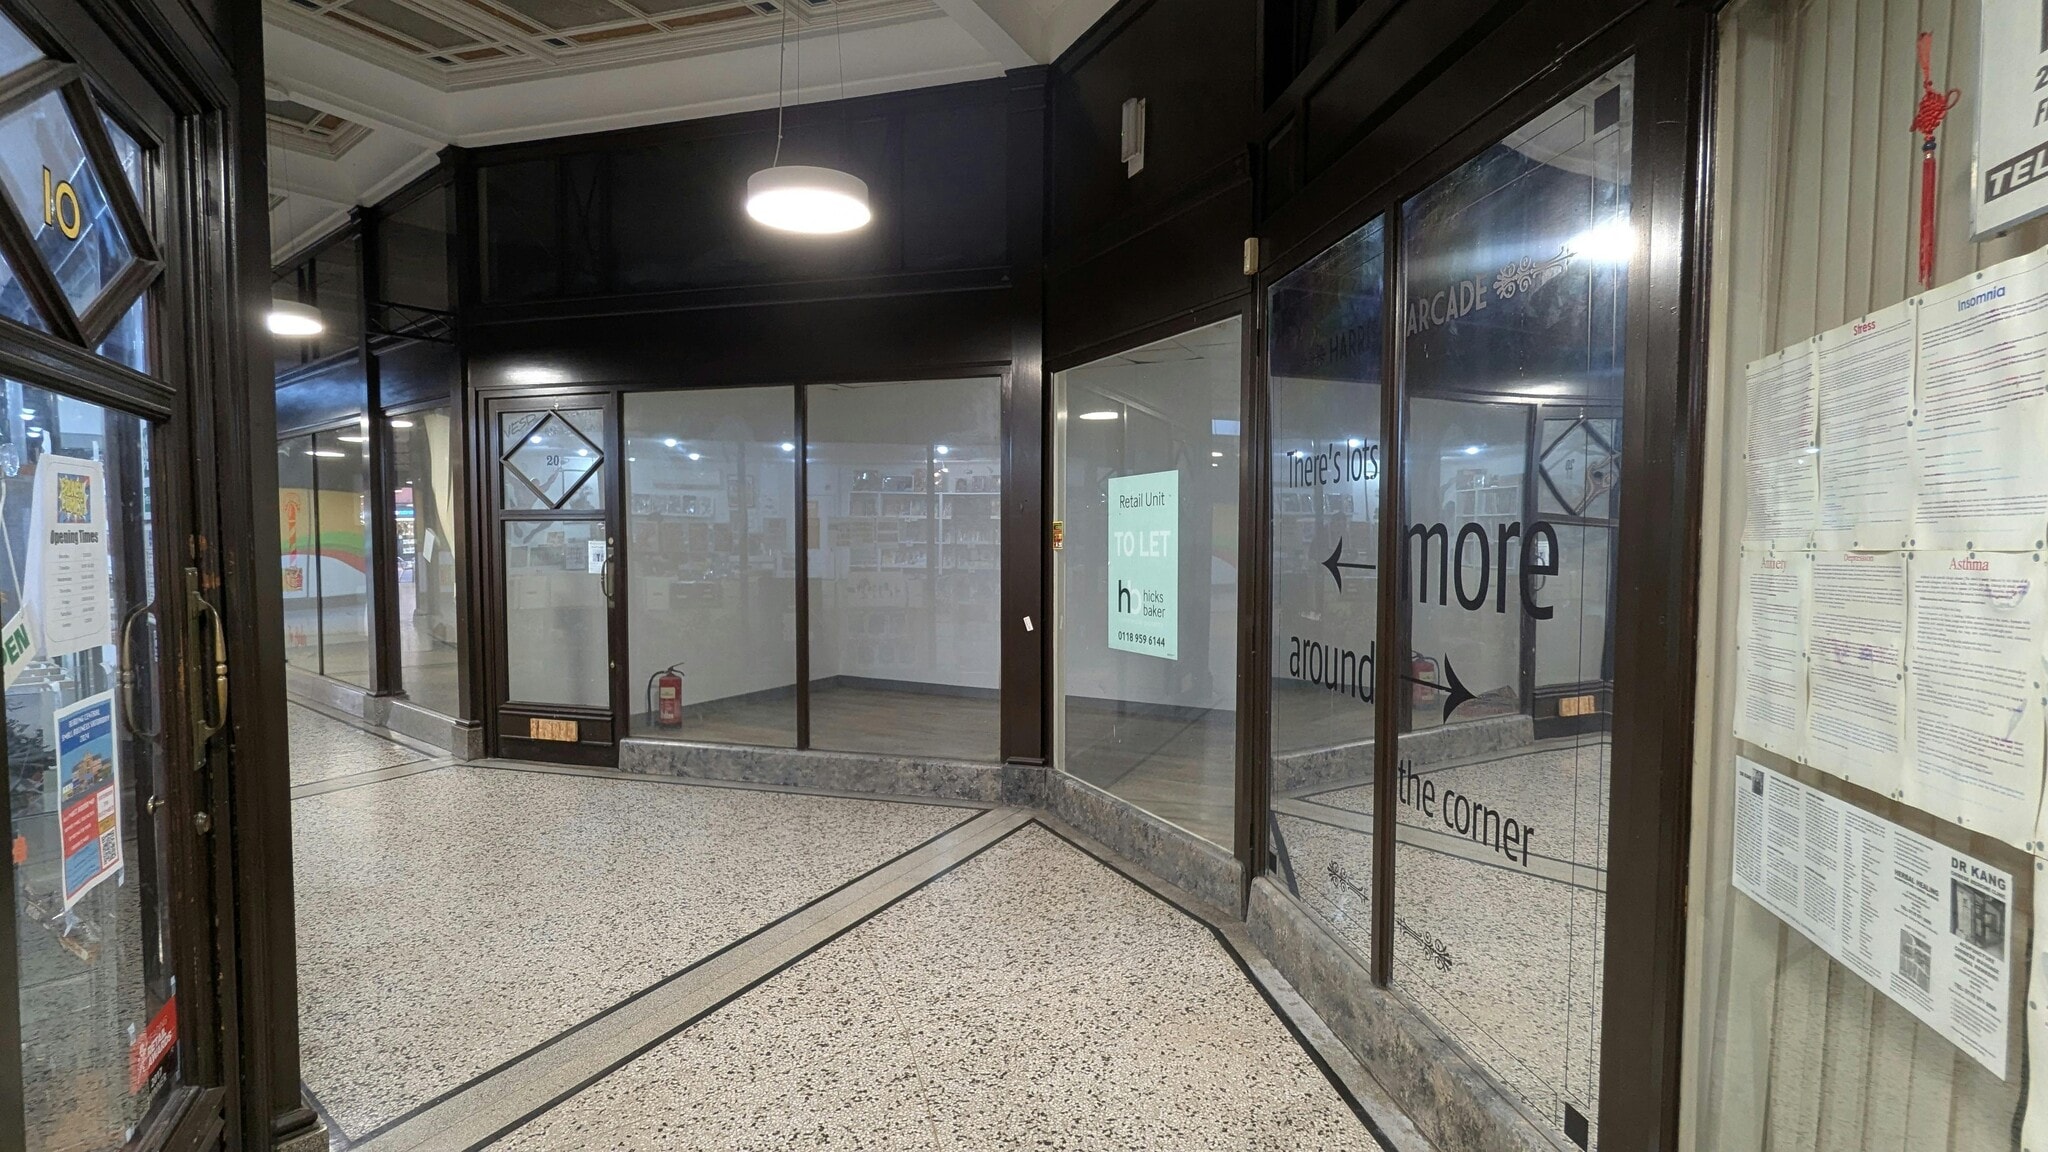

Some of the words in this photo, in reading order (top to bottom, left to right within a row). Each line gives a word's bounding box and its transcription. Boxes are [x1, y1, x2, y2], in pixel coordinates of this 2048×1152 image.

[43, 165, 81, 239] 10
[1407, 274, 1487, 338] ARCADE
[1958, 285, 2005, 312] Insomnia
[1853, 320, 1876, 336] Stress
[546, 454, 560, 466] 20
[1287, 443, 1341, 488] There's
[1346, 436, 1379, 482] lots
[1119, 493, 1144, 509] Retail
[1145, 492, 1165, 507] Unit
[50, 529, 78, 545] Opening
[79, 529, 98, 544] Times
[1114, 531, 1135, 557] TO
[1139, 530, 1171, 557] LET
[1403, 519, 1559, 619] more
[1949, 557, 1989, 571] Asthma
[1143, 589, 1164, 603] hicks
[1143, 605, 1166, 618] baker
[2, 623, 30, 668] EN
[1117, 630, 1134, 643] 0118
[1134, 632, 1147, 645] 959
[1148, 634, 1166, 648] 6144
[1289, 634, 1375, 704] around
[1398, 759, 1435, 818] the
[1443, 789, 1534, 867] corner
[1951, 857, 1967, 873] DR
[1971, 865, 2006, 890] KANG
